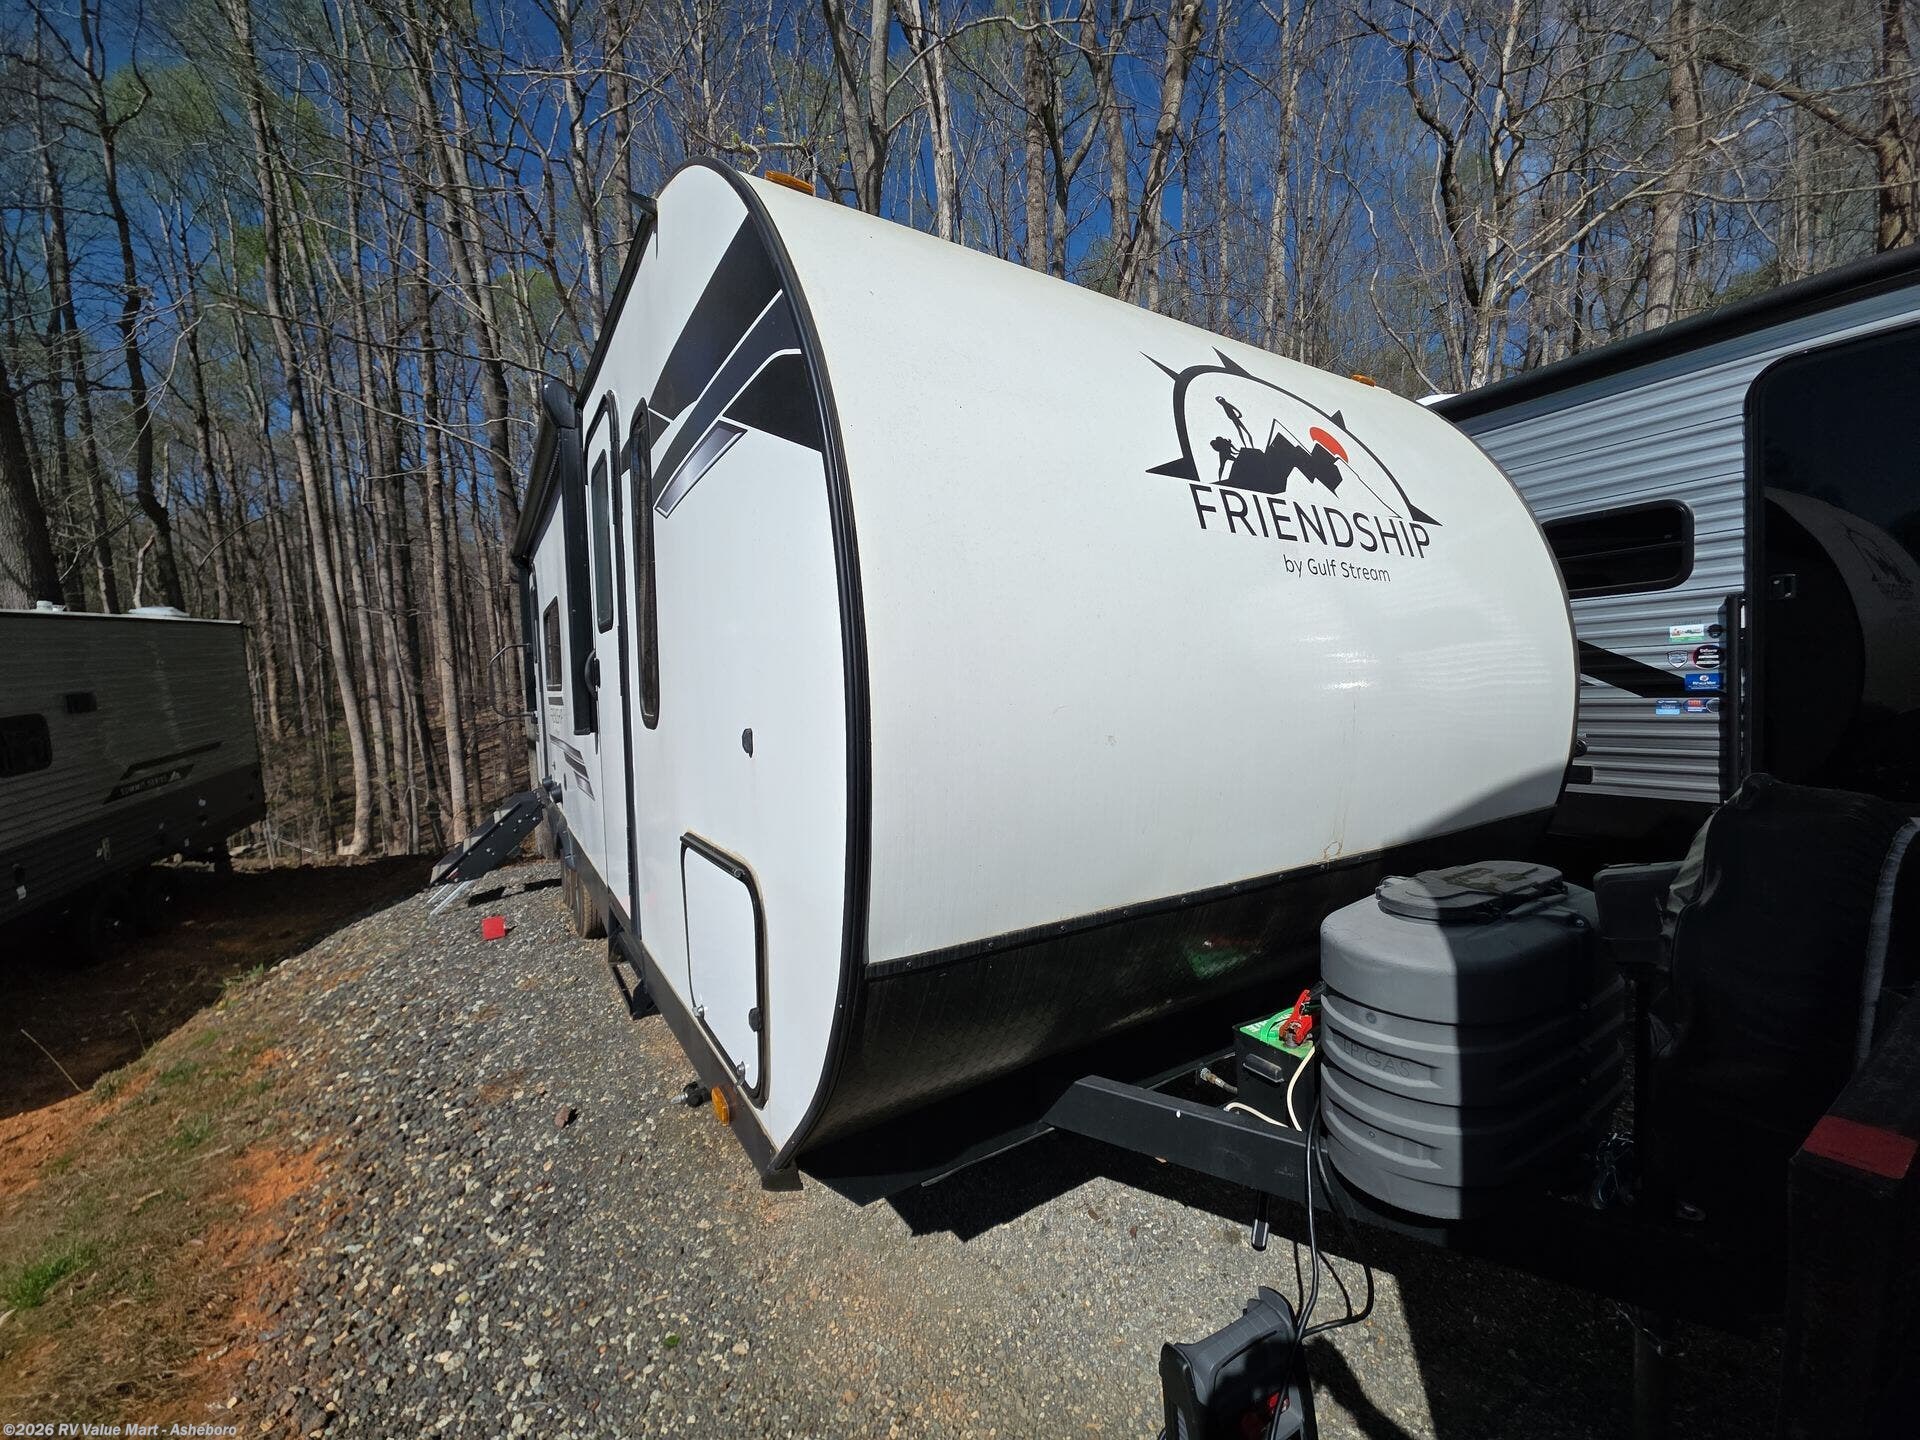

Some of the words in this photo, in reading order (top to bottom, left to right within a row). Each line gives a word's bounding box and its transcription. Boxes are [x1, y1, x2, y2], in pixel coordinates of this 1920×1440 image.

[1189, 483, 1430, 559] FRIENDSHIP
[1283, 554, 1303, 578] by
[1307, 557, 1337, 577] Gulf
[1340, 561, 1391, 582] Stream
[1365, 1050, 1410, 1078] GAS
